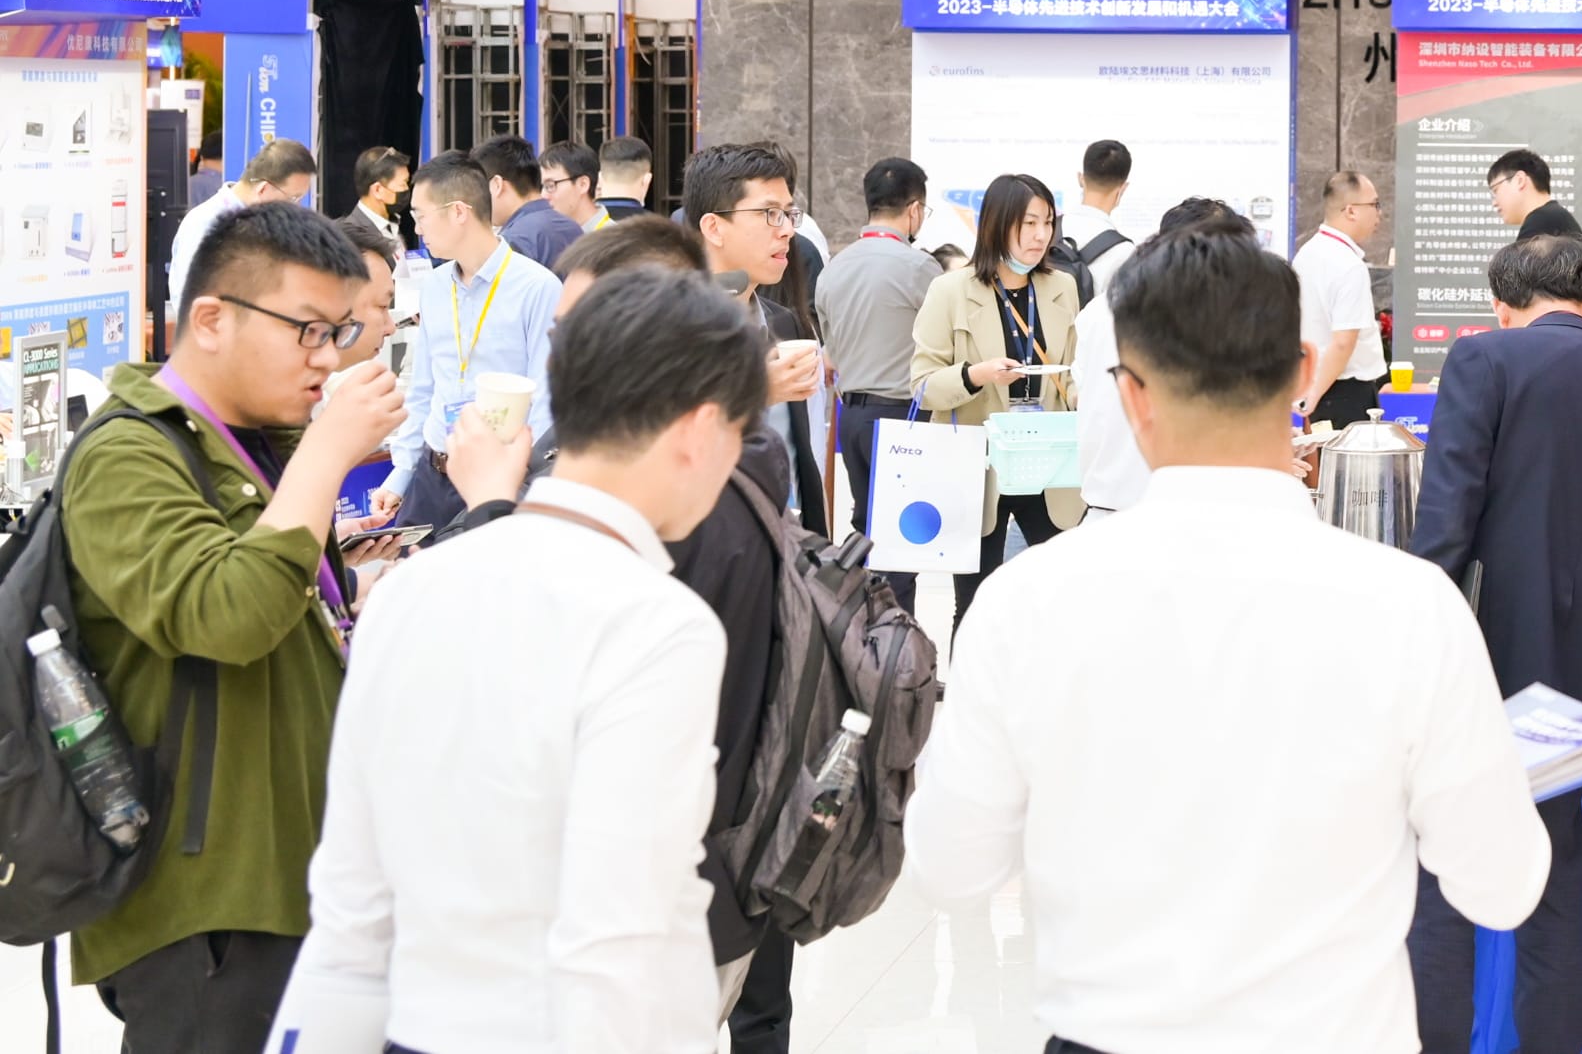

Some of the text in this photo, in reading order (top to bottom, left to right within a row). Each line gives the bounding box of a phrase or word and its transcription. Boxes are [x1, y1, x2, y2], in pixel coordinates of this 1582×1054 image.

[943, 65, 985, 76] eurofins
[1418, 118, 1471, 132] 企业介绍
[43, 348, 58, 360] Series
[1351, 489, 1388, 508] 咖啡
